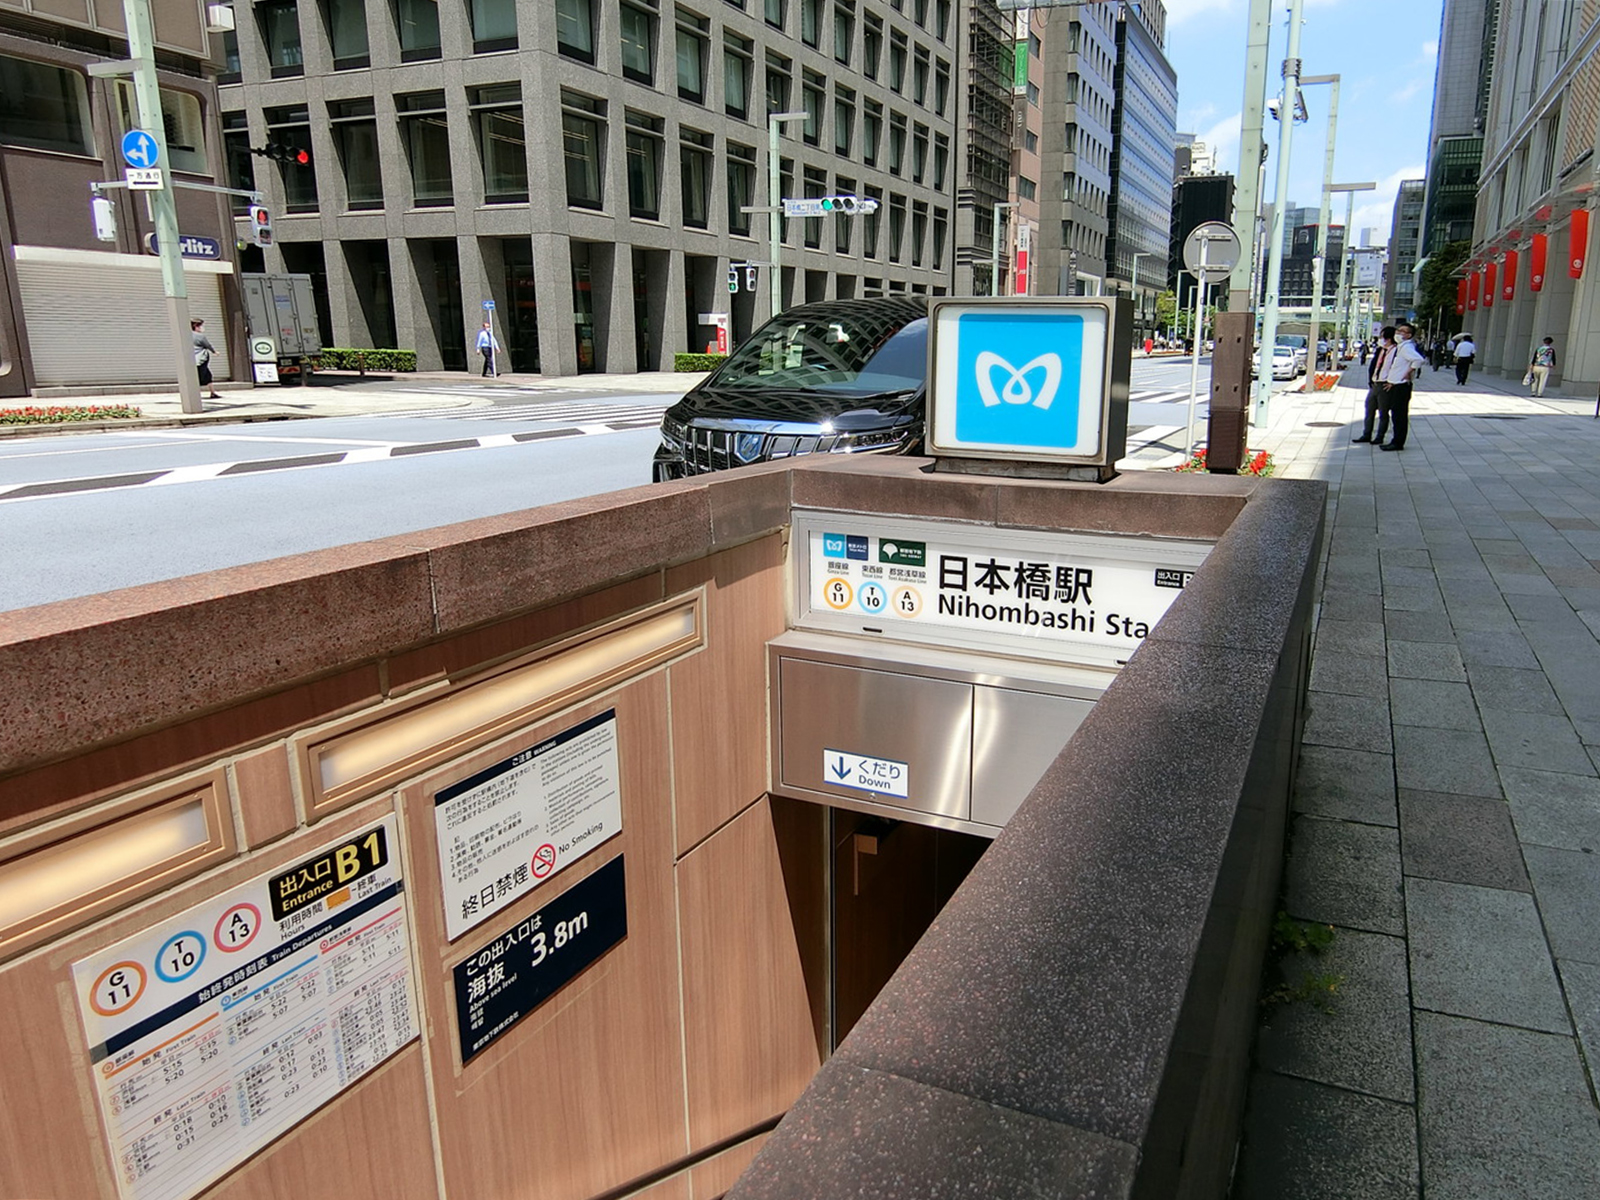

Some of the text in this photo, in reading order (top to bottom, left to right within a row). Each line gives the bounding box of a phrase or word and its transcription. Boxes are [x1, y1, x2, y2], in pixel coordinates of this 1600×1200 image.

[939, 554, 1094, 606] 日本橋駅
[1157, 571, 1180, 581] 出入口
[833, 593, 844, 602] 11
[834, 583, 842, 592] G
[870, 587, 875, 595] T
[903, 591, 911, 600] A
[866, 597, 880, 607] 10
[901, 601, 914, 612] 13
[938, 594, 1095, 632] Nihombashi
[858, 760, 900, 779] くだり
[858, 775, 891, 789] Down
[558, 821, 604, 855] No Smoking
[335, 832, 380, 884] B1
[280, 858, 331, 898] 出入口
[358, 877, 392, 899] Last Train
[282, 879, 333, 912] Entrance
[461, 862, 530, 920] 終日禁煙
[231, 912, 243, 928] A
[279, 901, 323, 931] 利用時間
[229, 924, 250, 944] 13
[281, 925, 305, 941] Hours
[531, 911, 588, 967] 3.8m
[174, 940, 184, 954] T
[466, 914, 543, 976] この出入口は
[171, 952, 195, 973] 10
[199, 959, 268, 1004] 始終発時刻表
[272, 947, 291, 962] Train
[292, 925, 333, 951] Departures
[109, 971, 125, 987] G
[468, 962, 505, 1003] 海抜
[108, 984, 131, 1005] 11
[469, 973, 518, 1014] Above sea level
